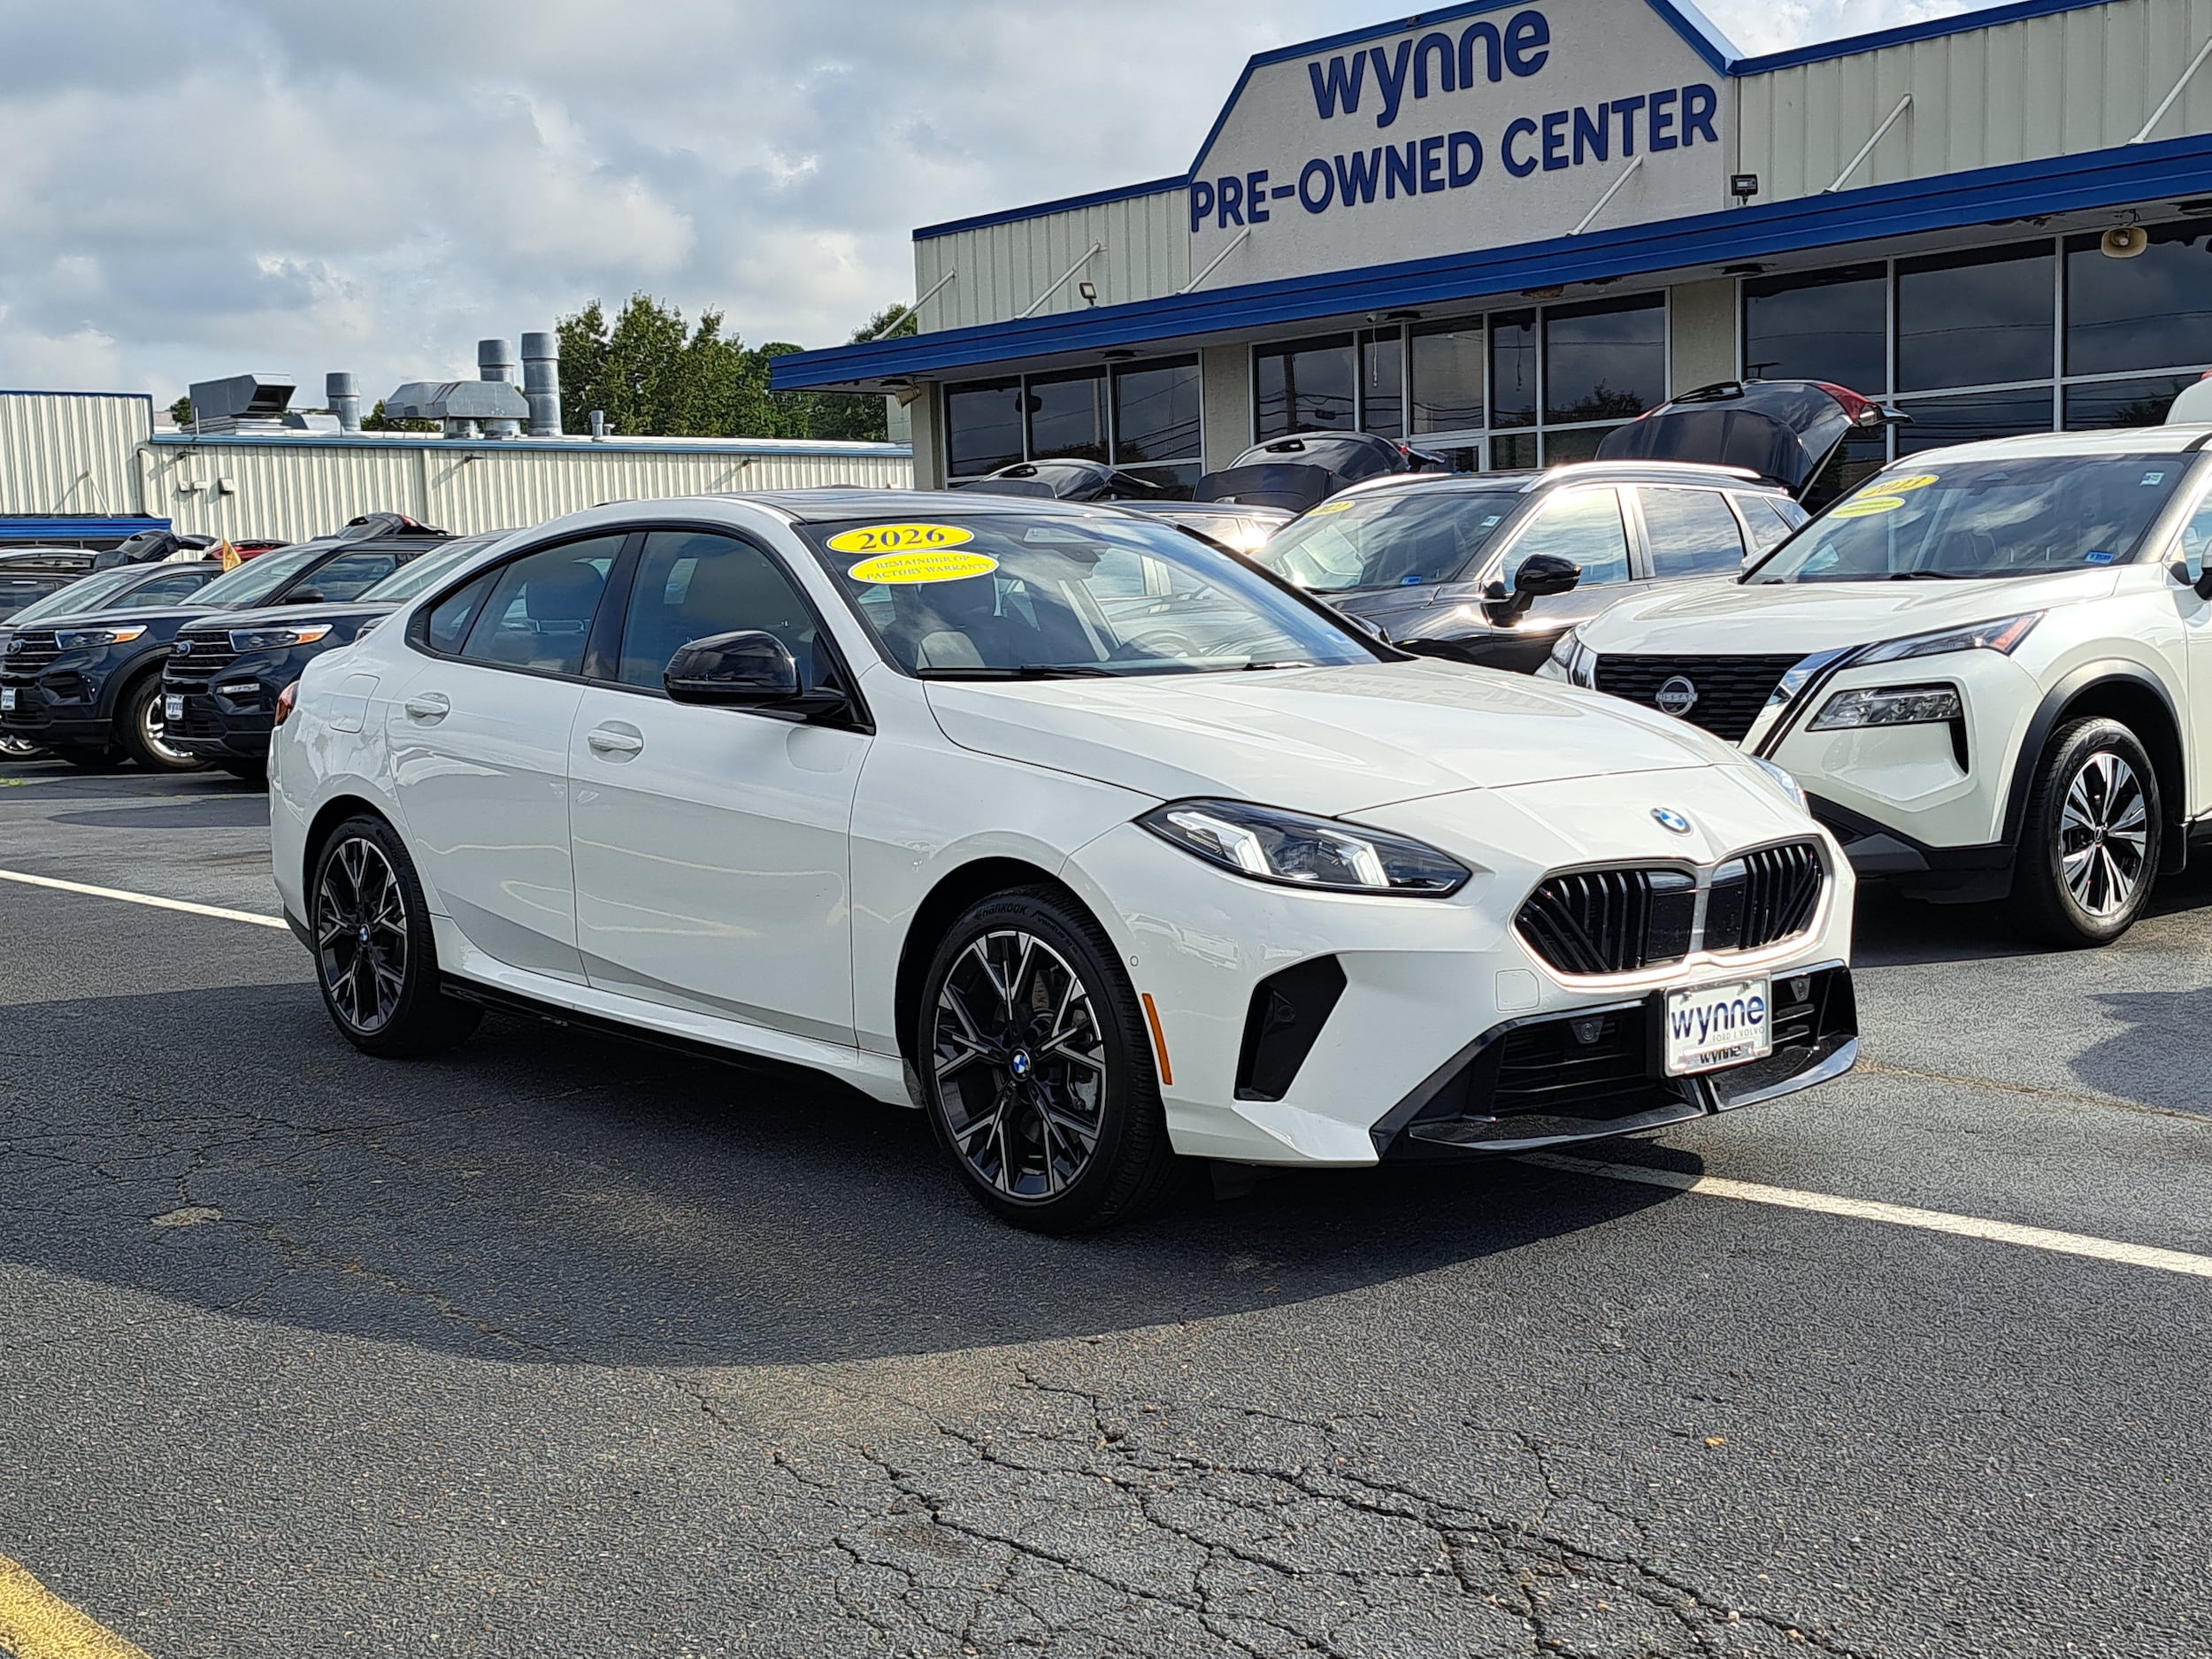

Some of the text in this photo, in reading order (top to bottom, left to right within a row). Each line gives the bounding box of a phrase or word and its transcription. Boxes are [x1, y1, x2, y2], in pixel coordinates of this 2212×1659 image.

[1309, 10, 1550, 128] wynne
[1190, 83, 1718, 233] PRE-OWNED CENTER
[856, 527, 945, 549] 2026
[866, 562, 991, 580] FACTORY WARRANTY
[876, 556, 952, 570] REMAINDER
[1655, 692, 1698, 703] NISSAN
[1671, 996, 1764, 1044] wynne
[1712, 1032, 1731, 1042] FORD
[1740, 1026, 1765, 1037] VOLVO
[1699, 1045, 1742, 1064] wynne
